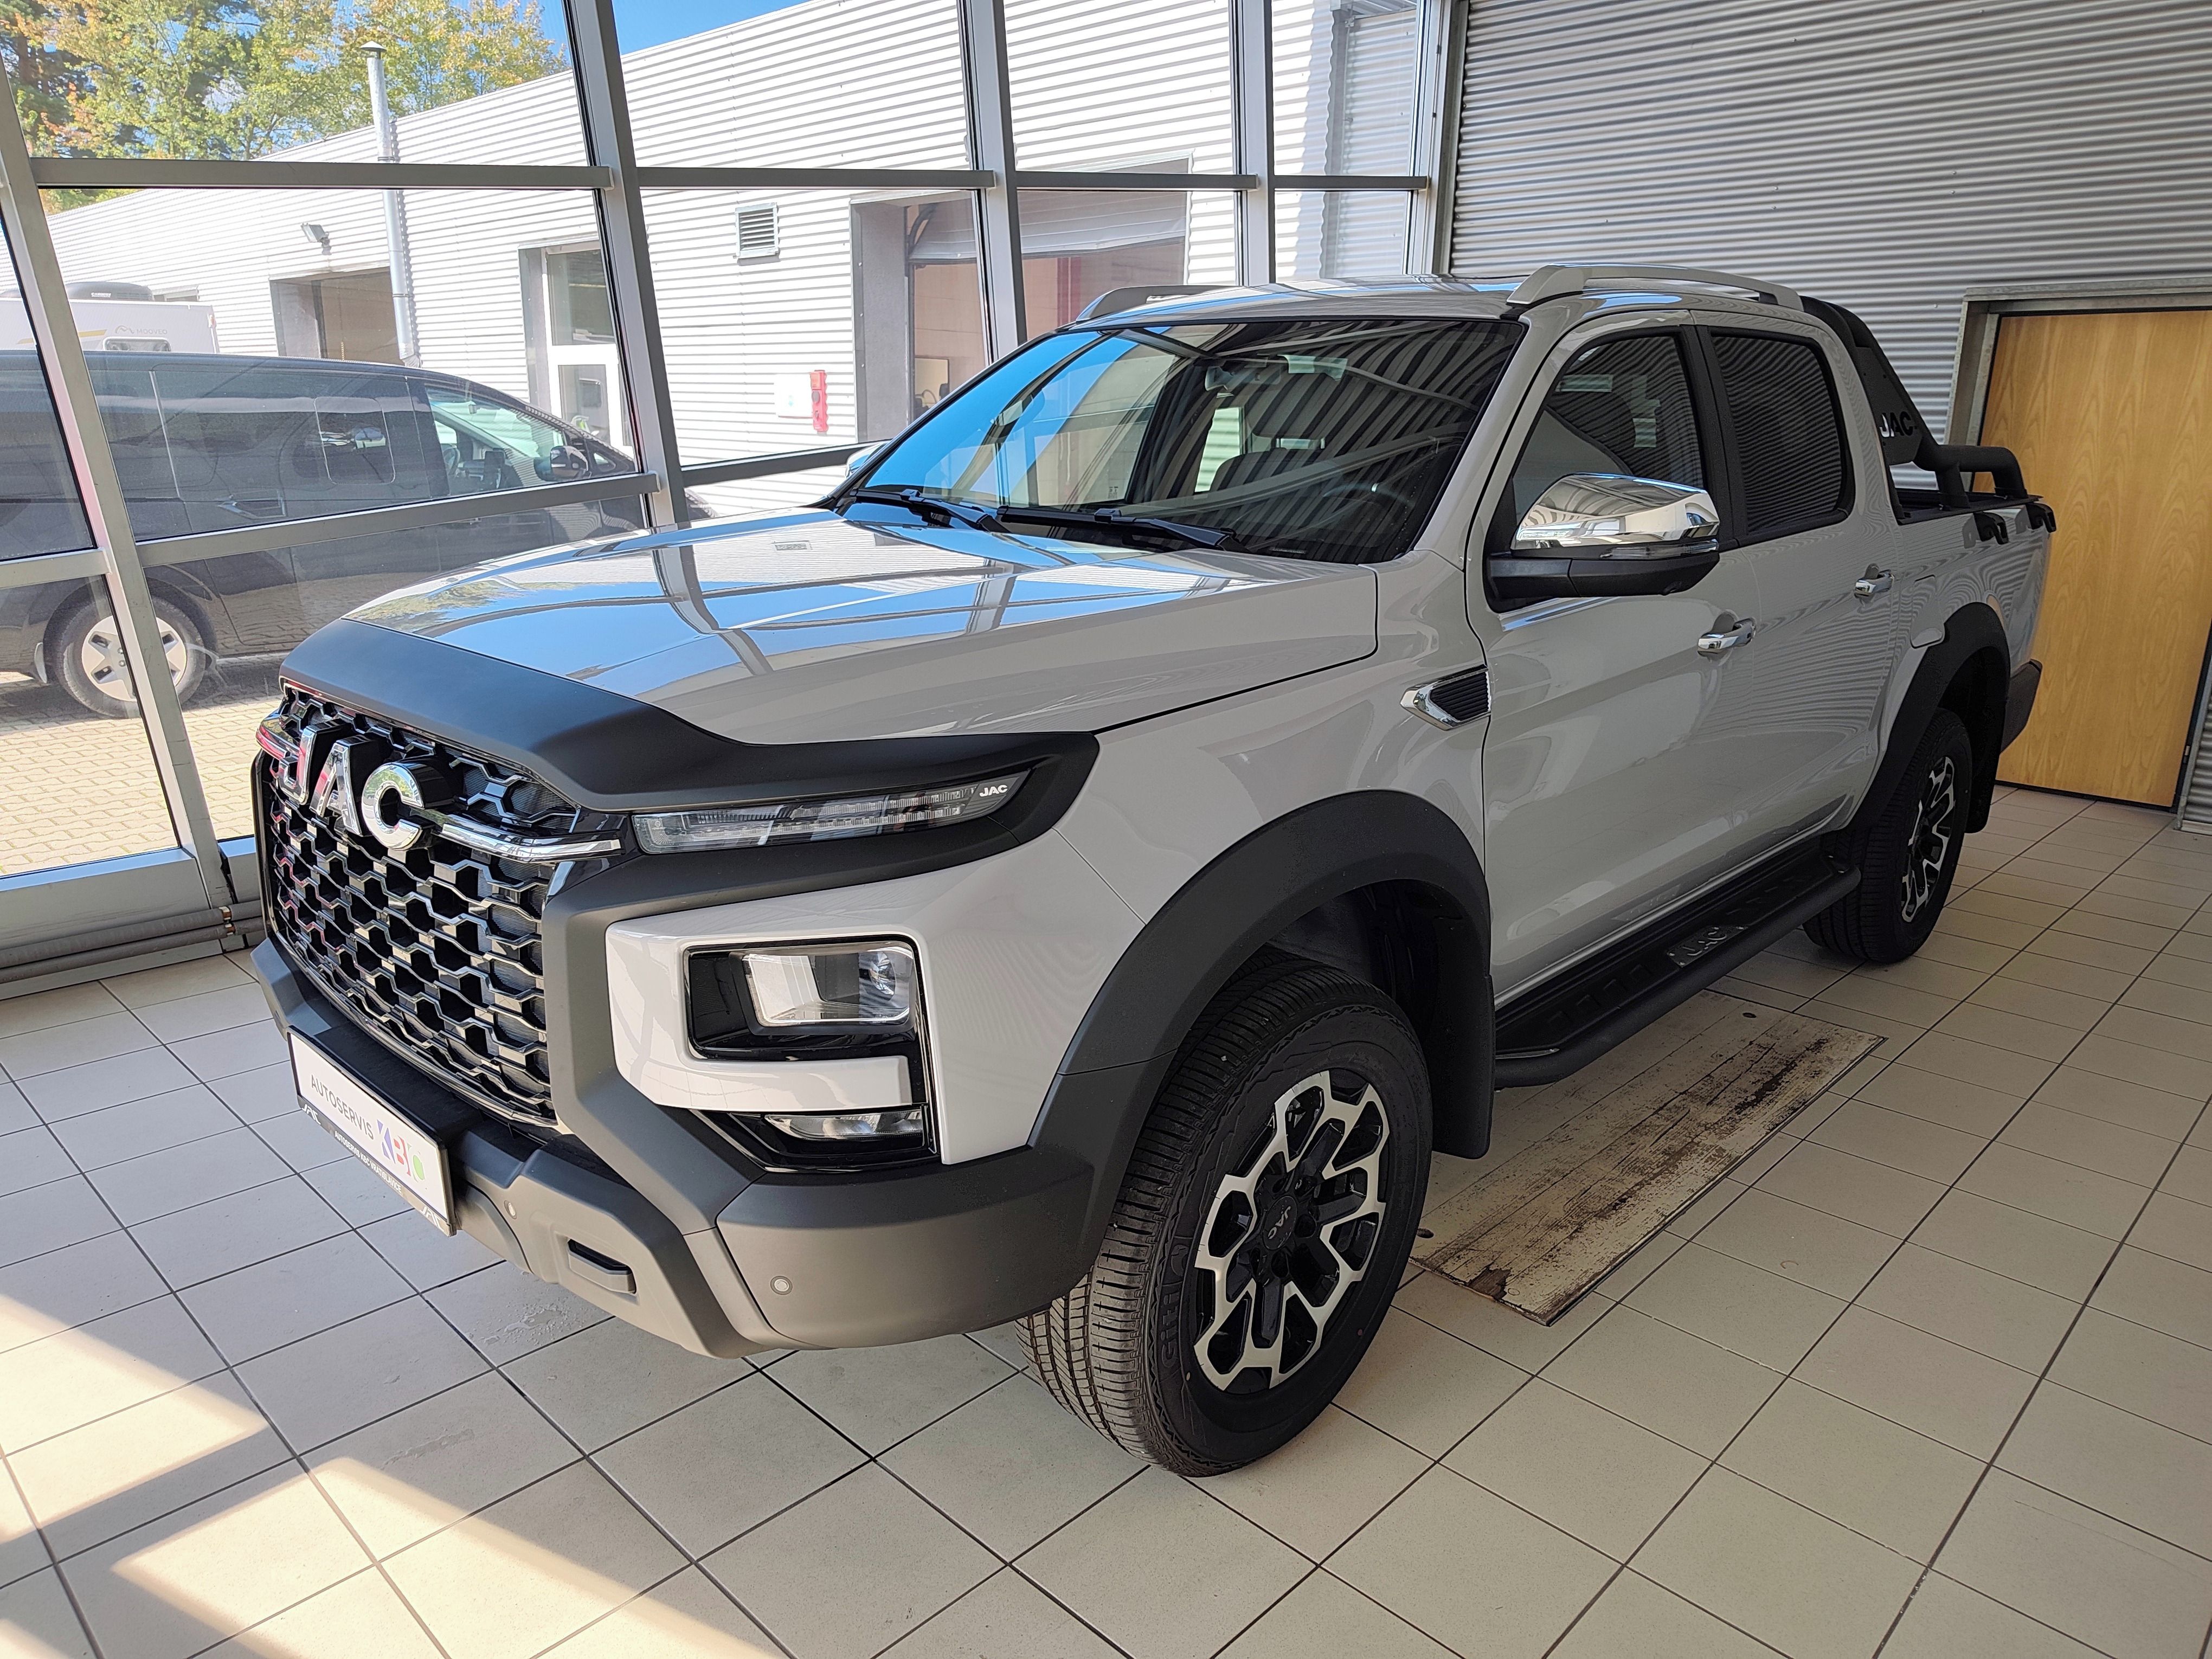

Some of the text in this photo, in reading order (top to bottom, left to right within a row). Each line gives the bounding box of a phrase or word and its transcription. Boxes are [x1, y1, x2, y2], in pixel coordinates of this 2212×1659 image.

[1879, 411, 1913, 438] JAC
[279, 723, 425, 851] JAC
[979, 785, 1008, 797] JAC
[301, 1103, 321, 1125] JAC
[311, 1074, 374, 1140] AUTOSERVIS
[335, 1130, 402, 1194] AUTOSERVIS KBC VRATISLAVICE
[420, 1206, 445, 1232] JAC
[1268, 1206, 1291, 1239] JAC
[1161, 1290, 1180, 1368] Giti
